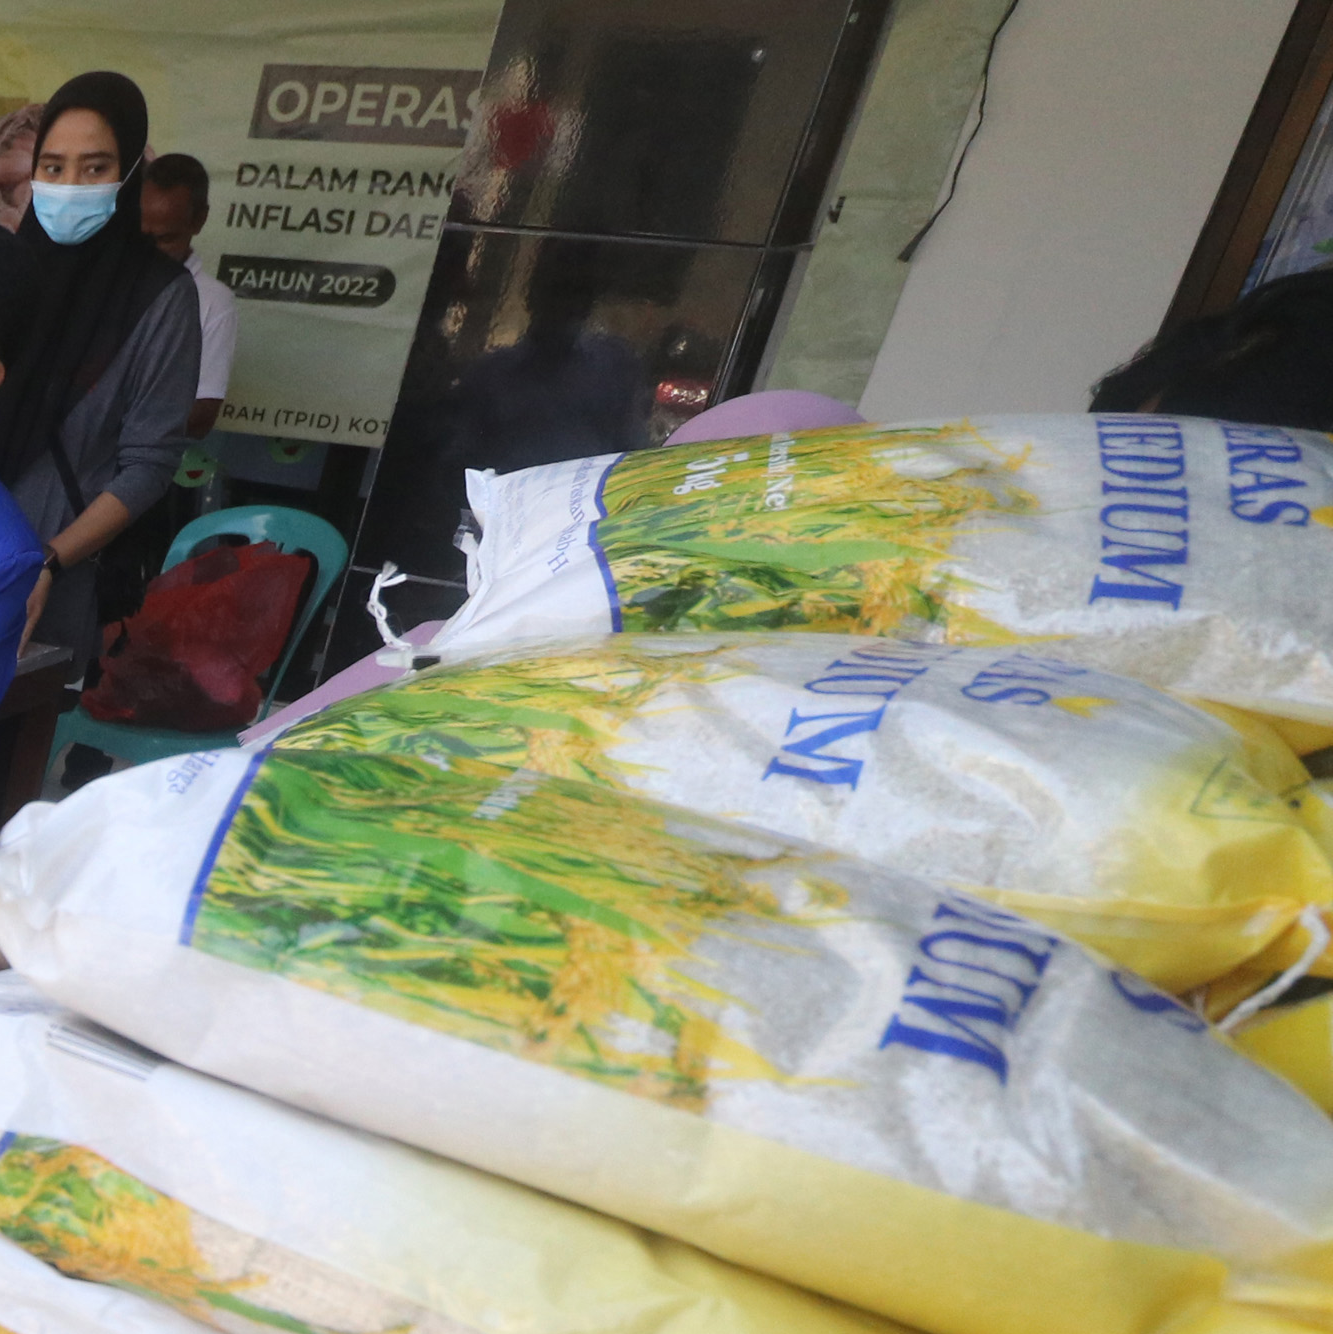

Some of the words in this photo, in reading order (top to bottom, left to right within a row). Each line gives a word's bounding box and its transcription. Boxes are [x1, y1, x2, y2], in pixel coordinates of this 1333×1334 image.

[236, 162, 358, 194] DALAM
[226, 203, 355, 236] INFLASI
[364, 211, 442, 241] DAE
[229, 267, 314, 292] TAHUN
[319, 275, 379, 297] 2022
[274, 408, 340, 433] (TPID)
